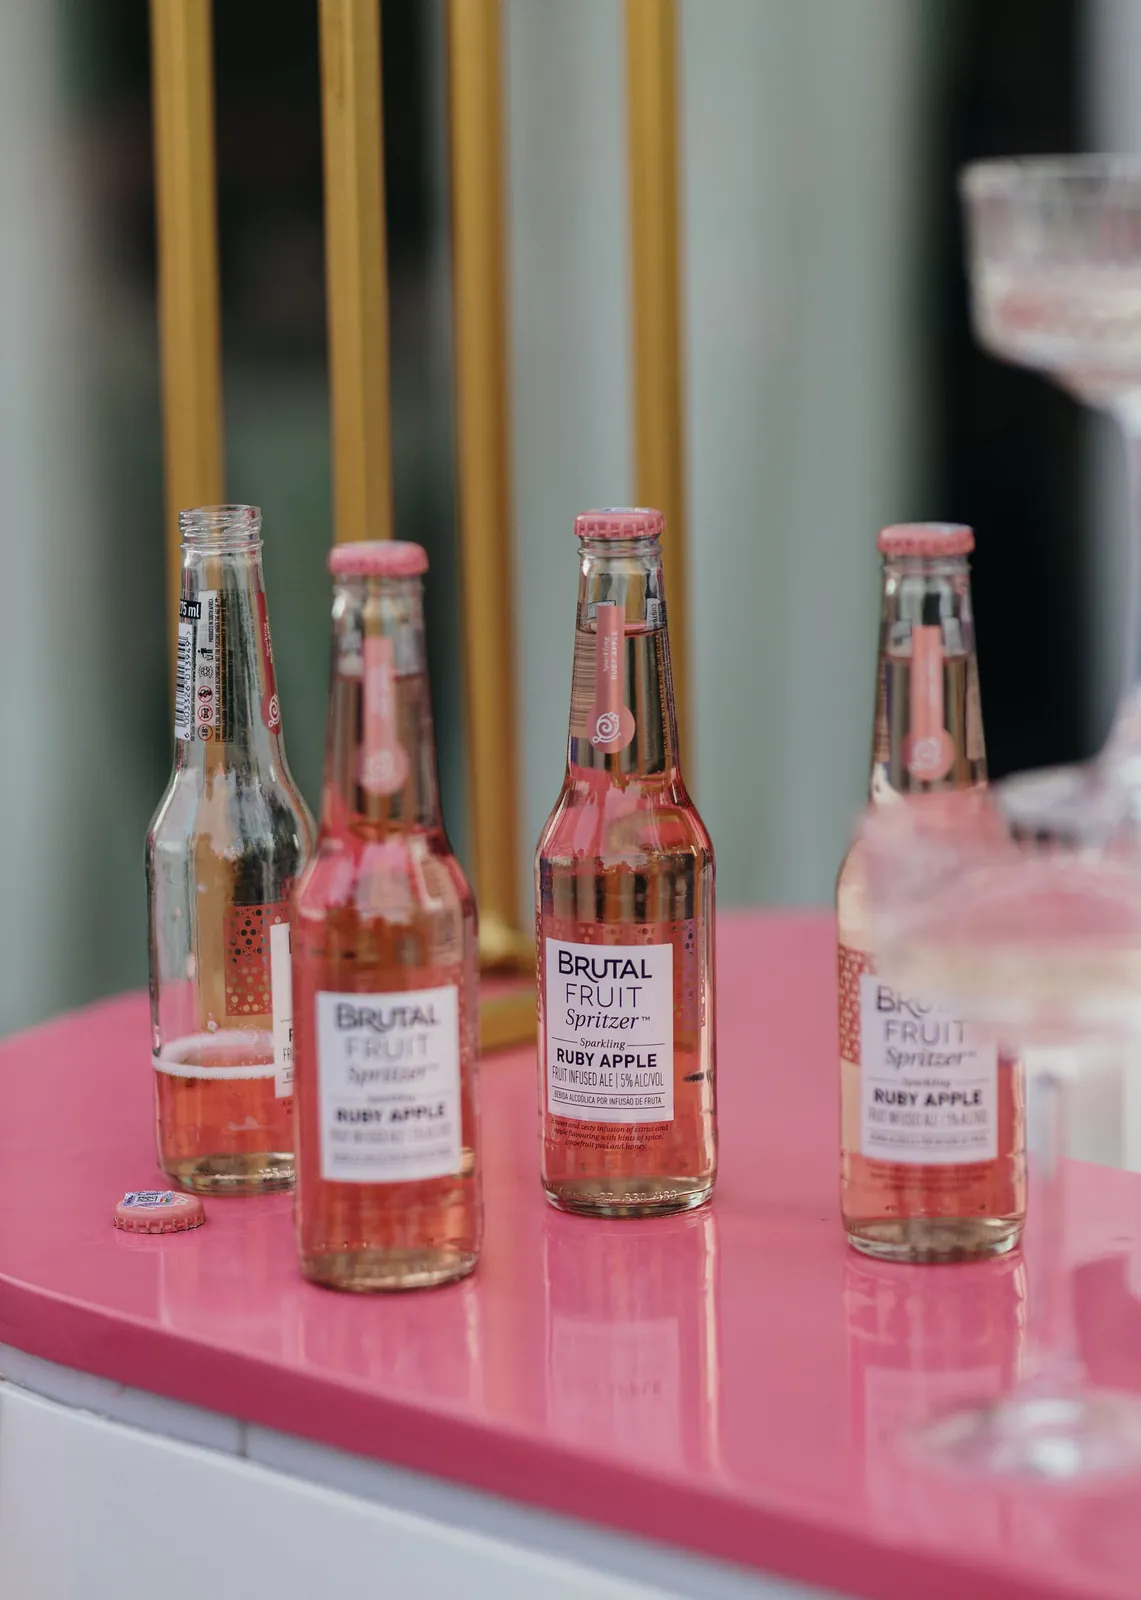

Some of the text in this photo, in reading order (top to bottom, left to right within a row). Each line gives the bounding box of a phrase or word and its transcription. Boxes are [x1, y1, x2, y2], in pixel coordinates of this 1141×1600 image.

[188, 603, 200, 618] ml
[558, 949, 653, 983] BRUTAL
[565, 982, 643, 1009] FRUIT
[335, 1001, 440, 1032] BRUTAL
[883, 1019, 965, 1046] FRUIT
[579, 1037, 626, 1051] Sparkling
[556, 1047, 658, 1069] RUBY APPLE
[552, 1066, 664, 1089] FRUIT INFUSED ALE 5% ALC/VOL
[553, 1089, 569, 1101] BEBIDA
[596, 1094, 608, 1105] POR
[635, 1095, 643, 1106] DE
[644, 1094, 662, 1105] FRUTA
[874, 1088, 983, 1107] RUBY APPLE
[390, 1102, 446, 1122] APPLE
